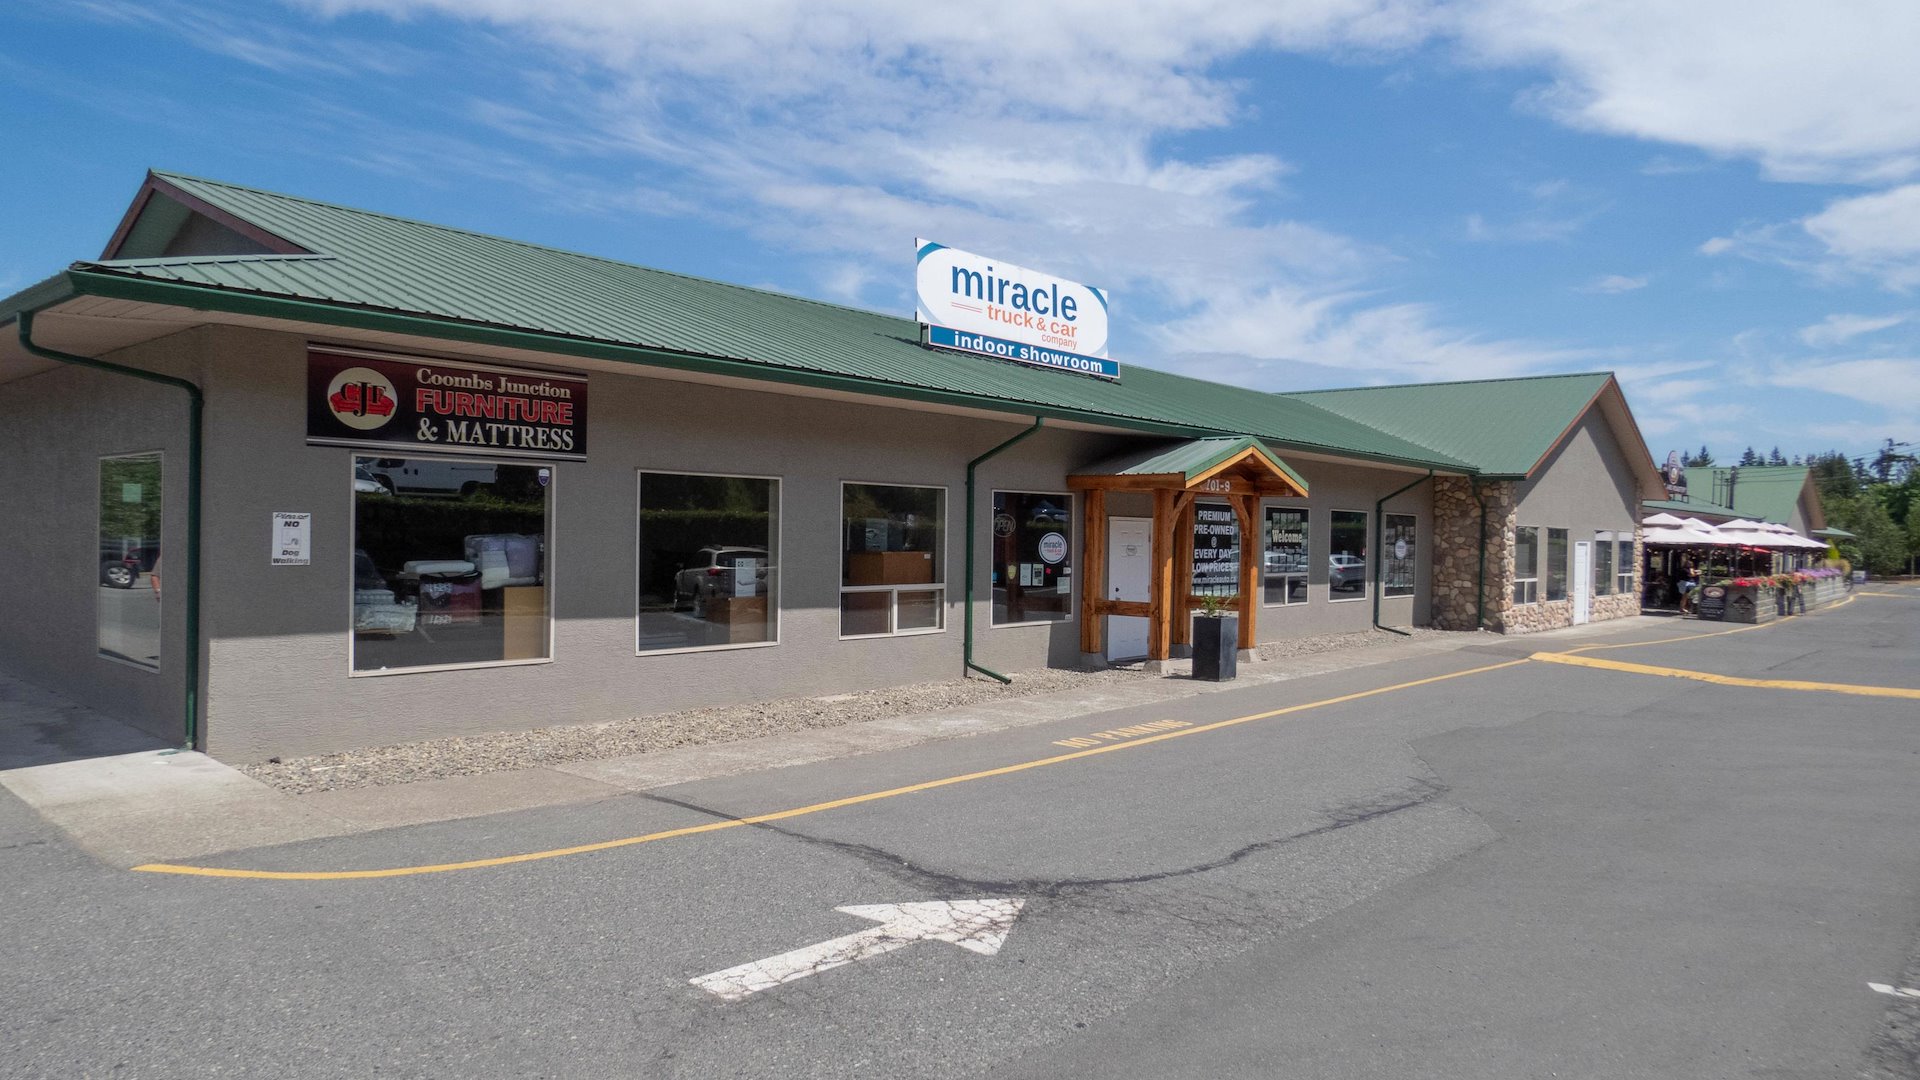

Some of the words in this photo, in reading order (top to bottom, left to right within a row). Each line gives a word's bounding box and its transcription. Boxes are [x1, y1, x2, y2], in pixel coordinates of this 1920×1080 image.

[952, 266, 1078, 321] miracle
[987, 304, 1034, 329] truck
[1036, 317, 1046, 331] &
[1050, 321, 1078, 338] car
[1041, 334, 1078, 350] company
[954, 331, 1015, 356] indoor
[1020, 346, 1103, 373] showroom
[416, 368, 493, 391] Coombs
[497, 377, 571, 399] Junction
[416, 388, 574, 425] FURNITURE
[416, 417, 438, 442] &
[446, 419, 574, 451] MATTRESS
[1198, 510, 1231, 521] PREMIUM
[1194, 524, 1234, 535] PRE-OWNED
[1271, 529, 1303, 543] Welcome
[282, 549, 300, 557] Dog
[1194, 548, 1217, 559] EVERY
[1219, 548, 1232, 559] DAY
[272, 557, 309, 565] Walking
[1192, 562, 1208, 573] LOW
[1052, 737, 1102, 749] NO
